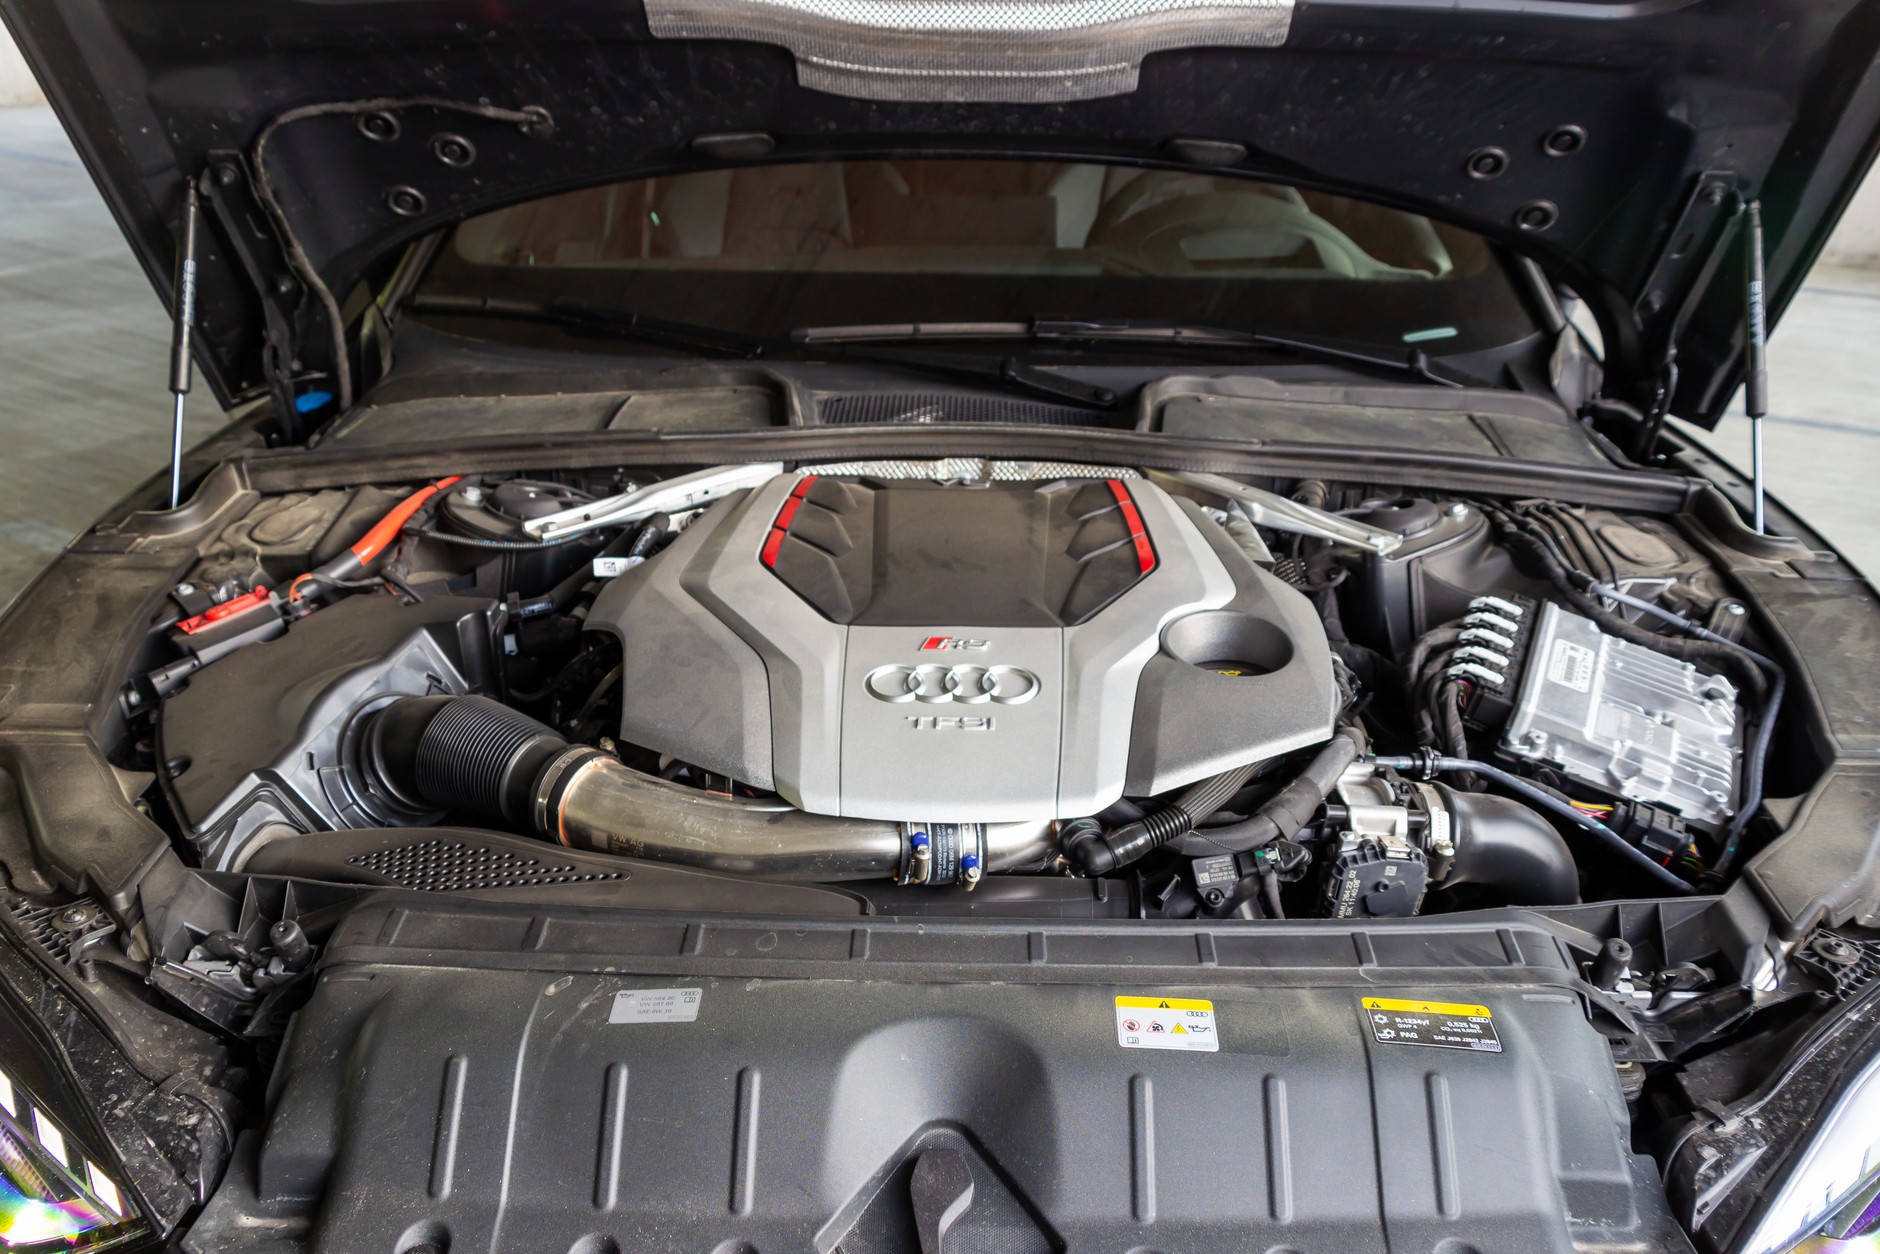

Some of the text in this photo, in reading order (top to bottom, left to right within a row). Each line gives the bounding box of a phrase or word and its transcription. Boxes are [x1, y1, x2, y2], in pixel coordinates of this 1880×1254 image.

[931, 636, 990, 652] RS
[905, 716, 995, 730] TFSI
[612, 832, 626, 843] VW
[1337, 902, 1348, 918] MMU
[1346, 907, 1354, 916] SK
[1395, 1017, 1430, 1026] R-1234yf
[1469, 1022, 1480, 1030] kg
[1400, 1031, 1418, 1039] PAG
